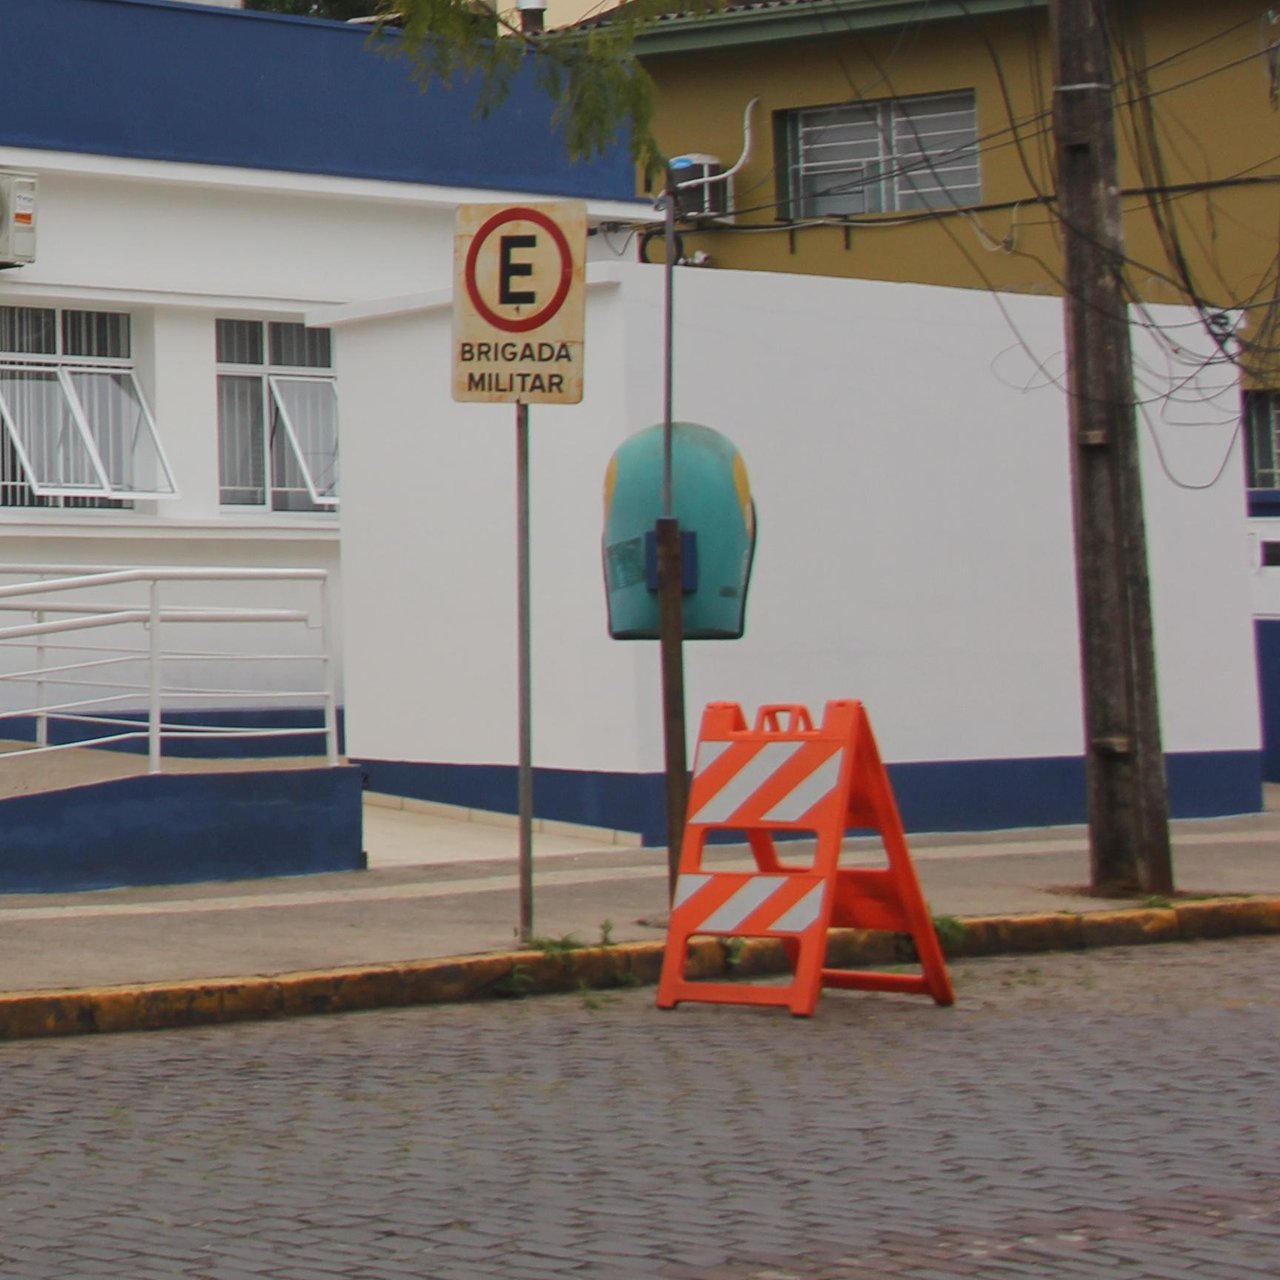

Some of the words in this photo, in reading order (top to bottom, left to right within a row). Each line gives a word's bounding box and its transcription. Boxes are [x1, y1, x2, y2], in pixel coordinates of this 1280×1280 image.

[498, 234, 537, 305] E
[460, 342, 573, 363] BRIGADA
[467, 372, 564, 394] MILITAR
